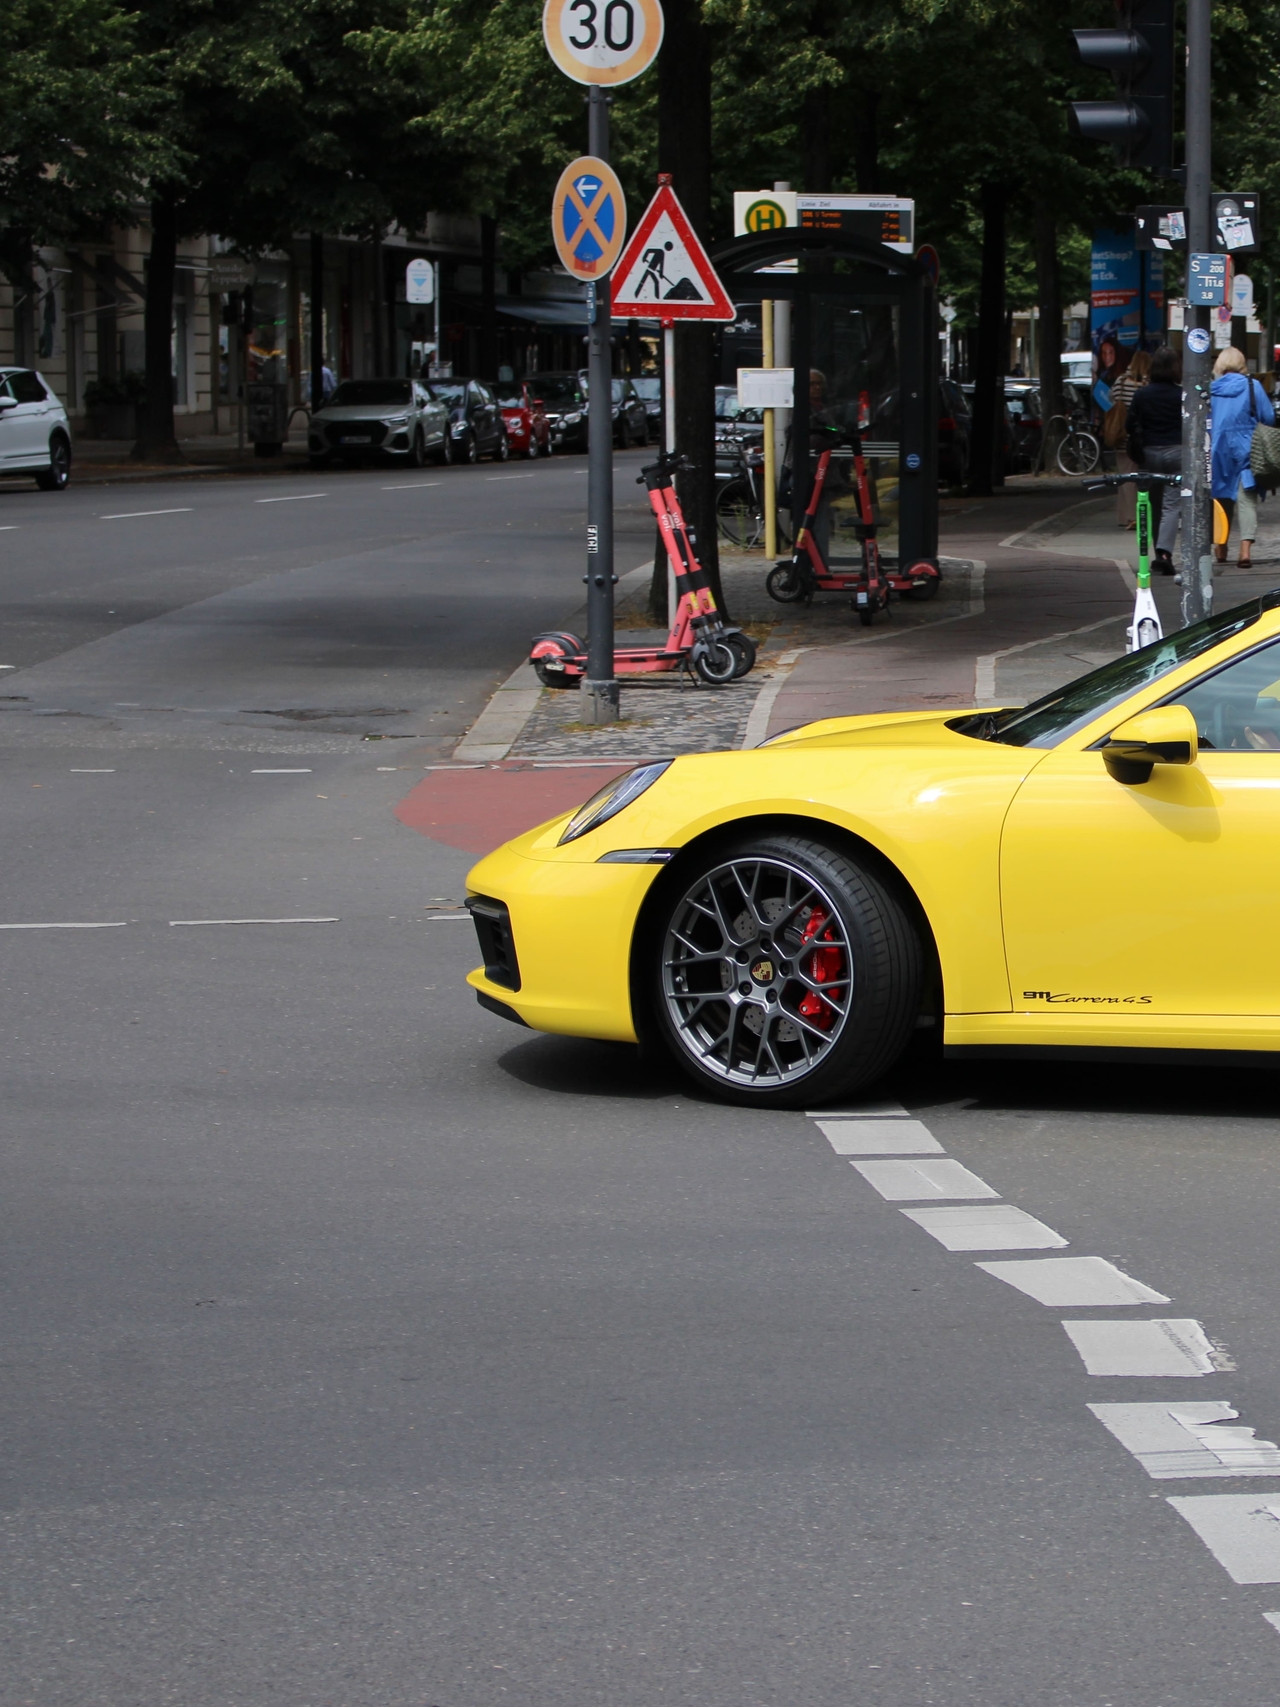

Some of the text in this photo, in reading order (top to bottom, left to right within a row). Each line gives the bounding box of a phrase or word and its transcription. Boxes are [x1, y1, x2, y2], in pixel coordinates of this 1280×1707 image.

[569, 0, 634, 51] 30
[1191, 260, 1200, 272] S
[1201, 291, 1213, 299] 3.8
[1023, 991, 1050, 999] 911
[1046, 993, 1120, 1004] Carrera
